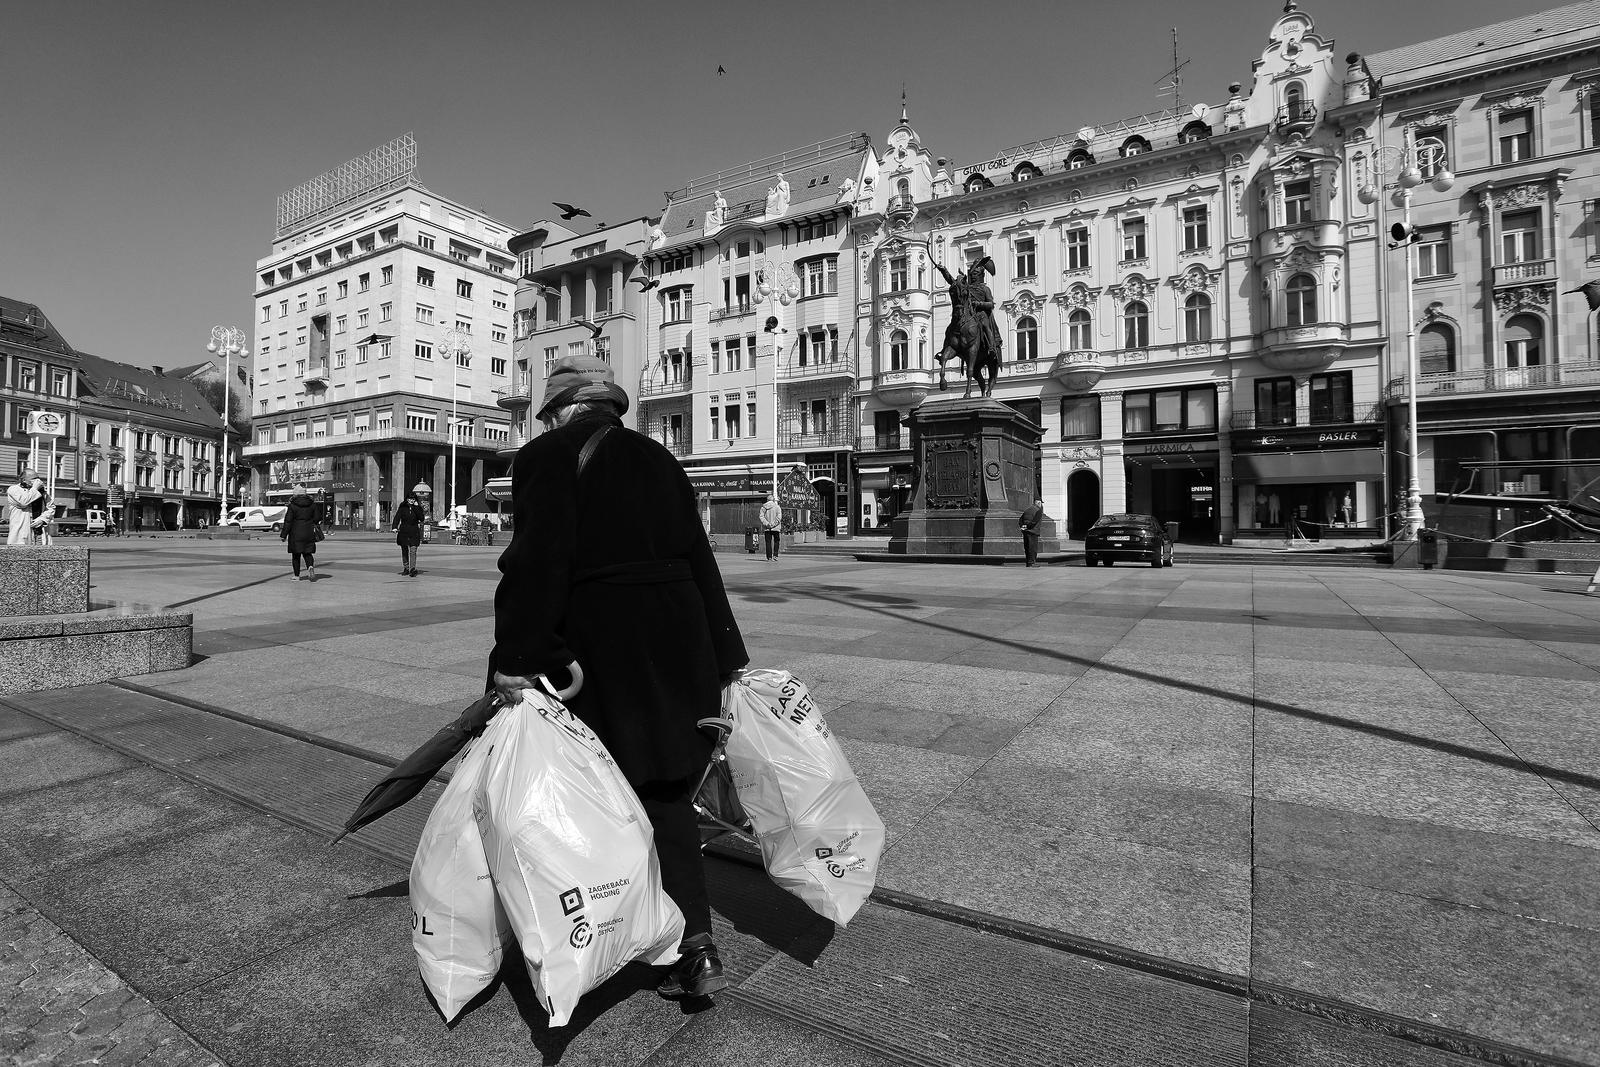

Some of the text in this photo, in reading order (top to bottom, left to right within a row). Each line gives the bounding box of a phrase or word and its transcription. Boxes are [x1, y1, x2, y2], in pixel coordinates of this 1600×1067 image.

[963, 164, 986, 176] GLAVU
[1319, 431, 1358, 442] BASLER
[1144, 443, 1194, 454] HARMICA
[588, 878, 630, 894] ZAGREBAČKI
[591, 889, 620, 900] HOLDING
